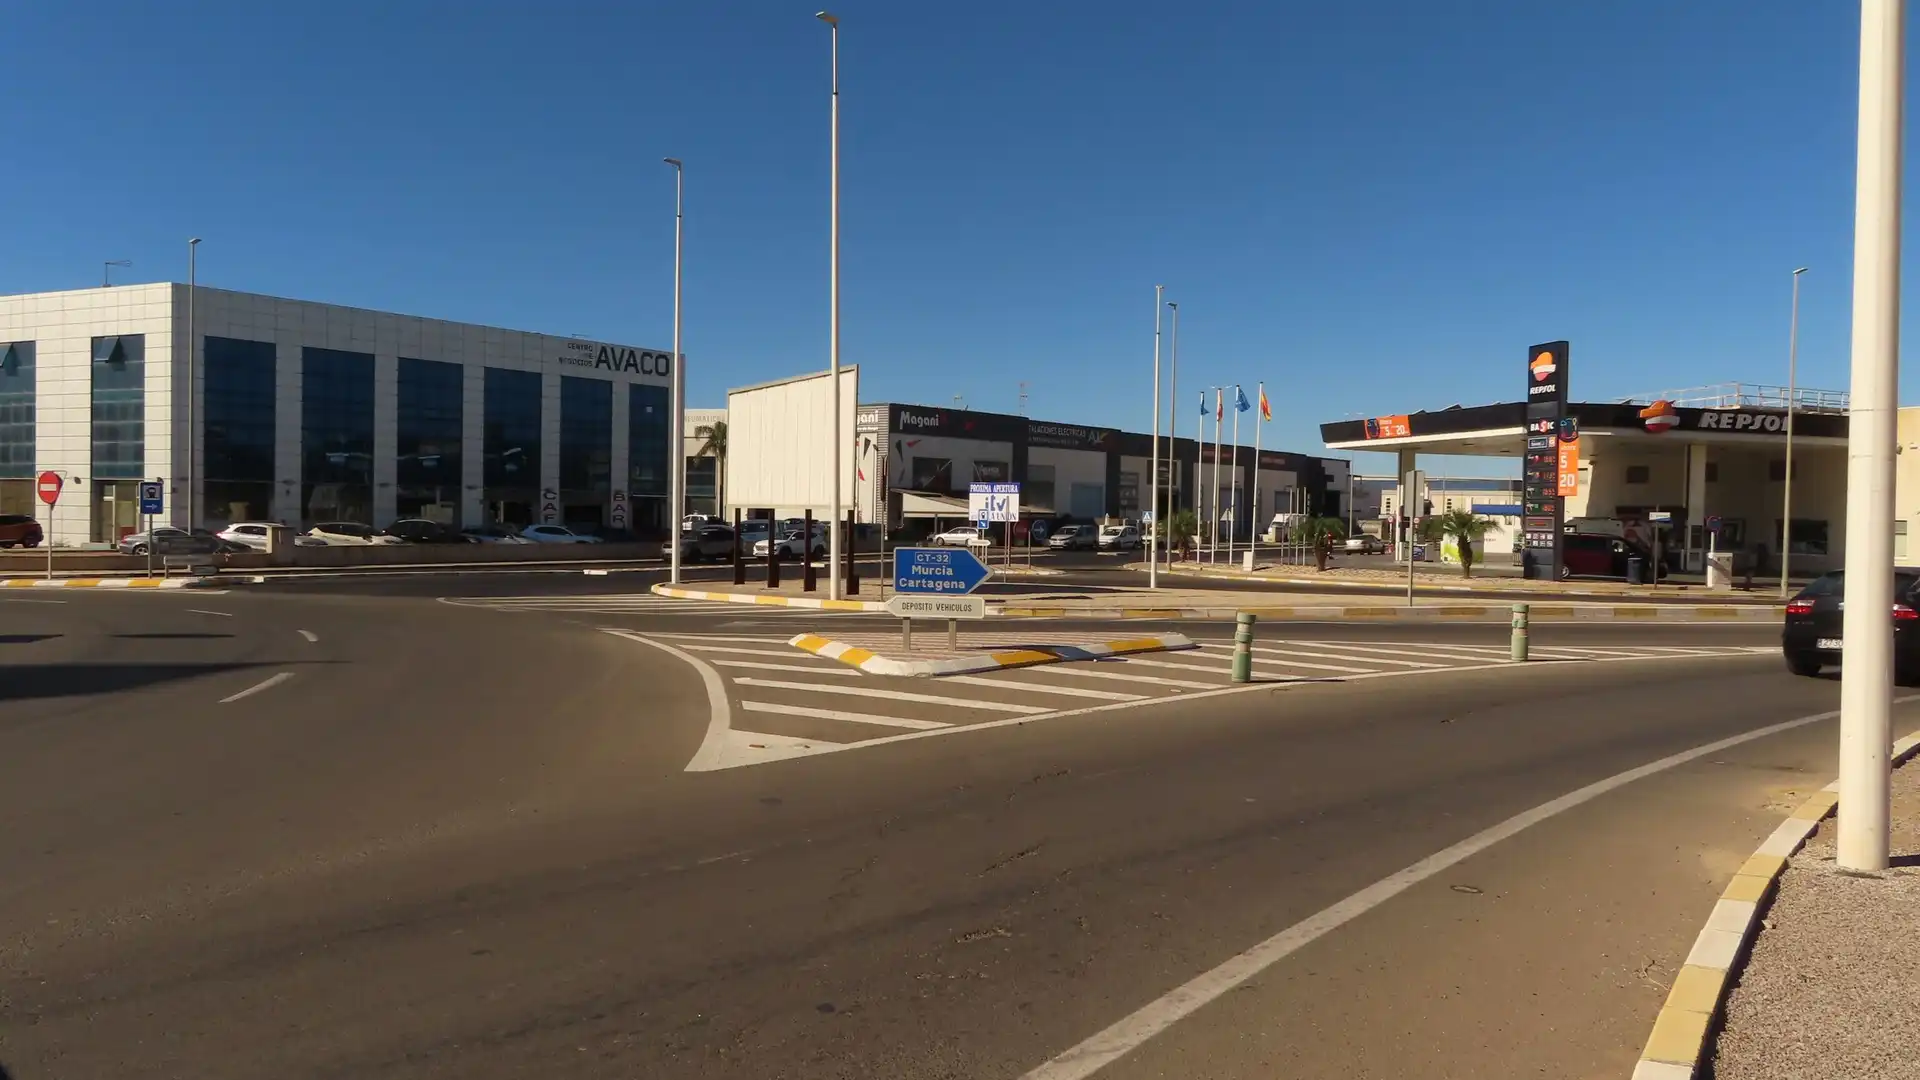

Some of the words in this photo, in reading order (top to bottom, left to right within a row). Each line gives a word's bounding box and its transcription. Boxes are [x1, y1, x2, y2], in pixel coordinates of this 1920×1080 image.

[594, 345, 670, 377] AVACO
[1529, 384, 1556, 395] REPSOL
[1530, 420, 1555, 433] BASIC
[1560, 455, 1568, 469] 5
[1560, 473, 1576, 488] 20
[970, 484, 991, 492] PROXIMA
[993, 484, 1018, 492] APERTURA
[612, 492, 626, 529] BAR
[917, 553, 949, 562] CT-32
[912, 565, 953, 575] Murcia
[899, 578, 965, 591] Cartagena
[902, 602, 933, 611] DEPOSITO
[935, 604, 972, 612] VEHICULOS
